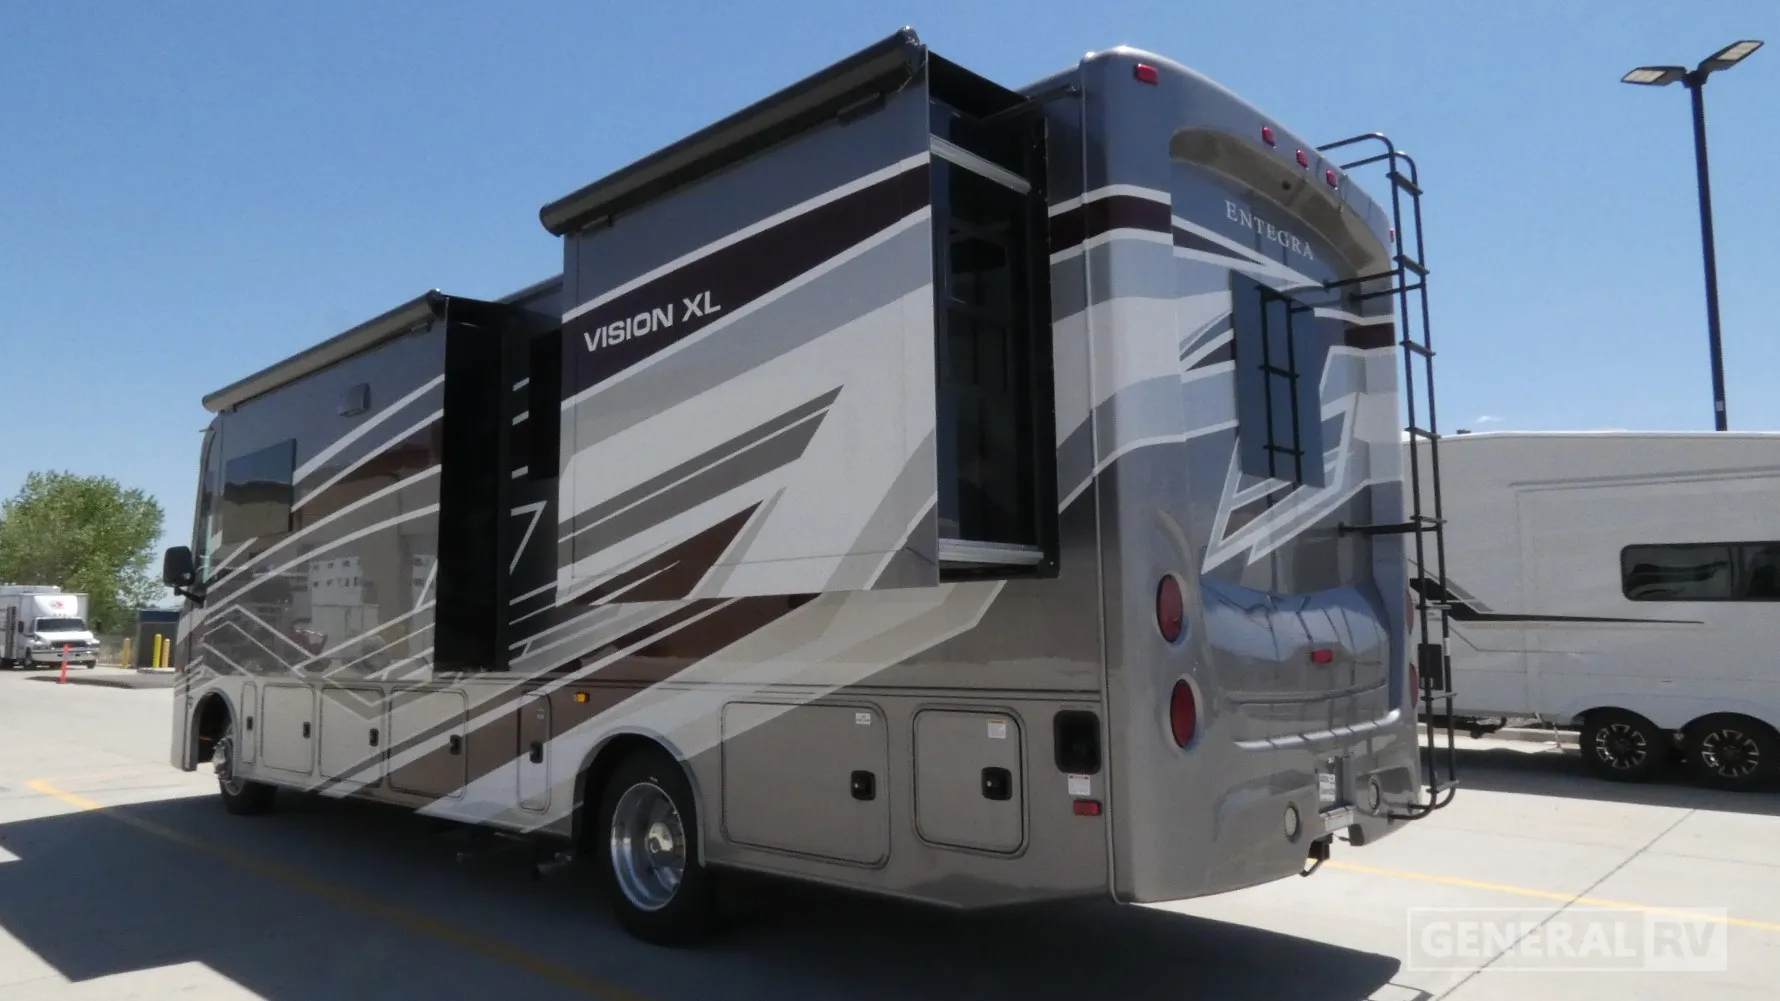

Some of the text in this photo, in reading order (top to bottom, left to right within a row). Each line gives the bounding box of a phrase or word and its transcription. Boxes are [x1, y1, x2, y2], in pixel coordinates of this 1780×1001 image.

[1225, 200, 1314, 261] ENTEGRA
[583, 290, 722, 352] VISION XL
